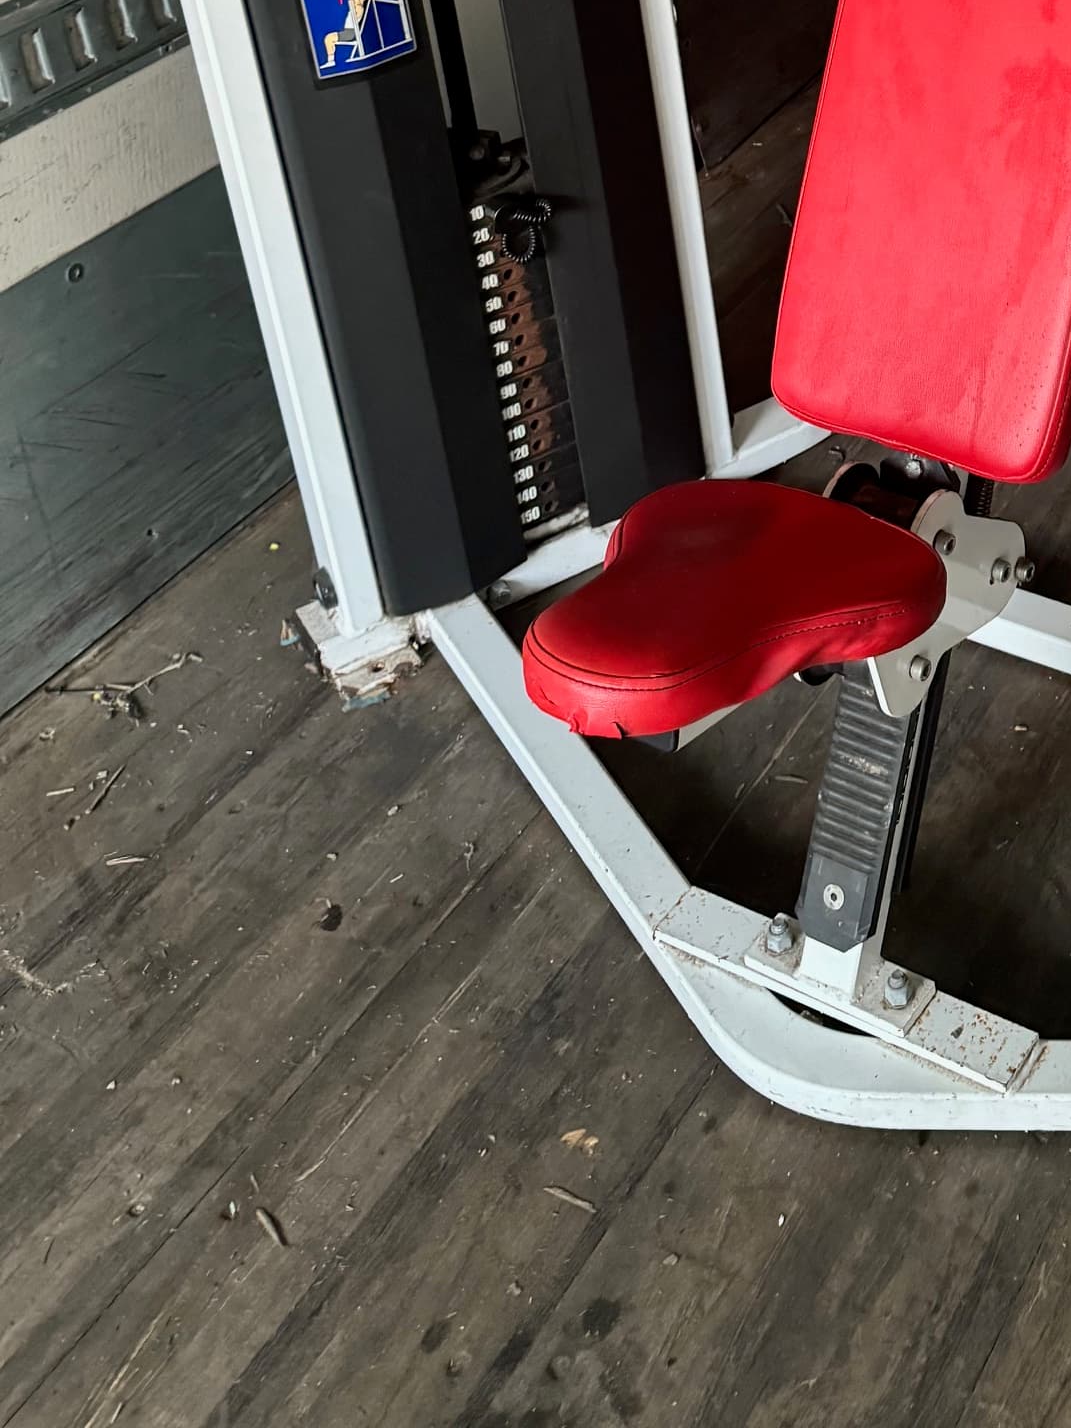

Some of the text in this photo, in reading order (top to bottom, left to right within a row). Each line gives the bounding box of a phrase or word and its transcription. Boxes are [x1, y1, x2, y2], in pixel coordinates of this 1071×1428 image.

[469, 205, 485, 222] 10
[473, 227, 490, 245] 20
[477, 250, 496, 268] 30
[482, 273, 499, 290] 40
[485, 296, 502, 313] 50
[489, 318, 507, 335] 60
[493, 340, 510, 356] 70
[496, 360, 513, 377] 80
[500, 383, 517, 400] 90
[502, 403, 522, 421] 100
[507, 424, 526, 442] 110
[510, 444, 530, 462] 120
[514, 465, 534, 484] 130
[516, 485, 538, 505] 140
[520, 506, 541, 524] 150
